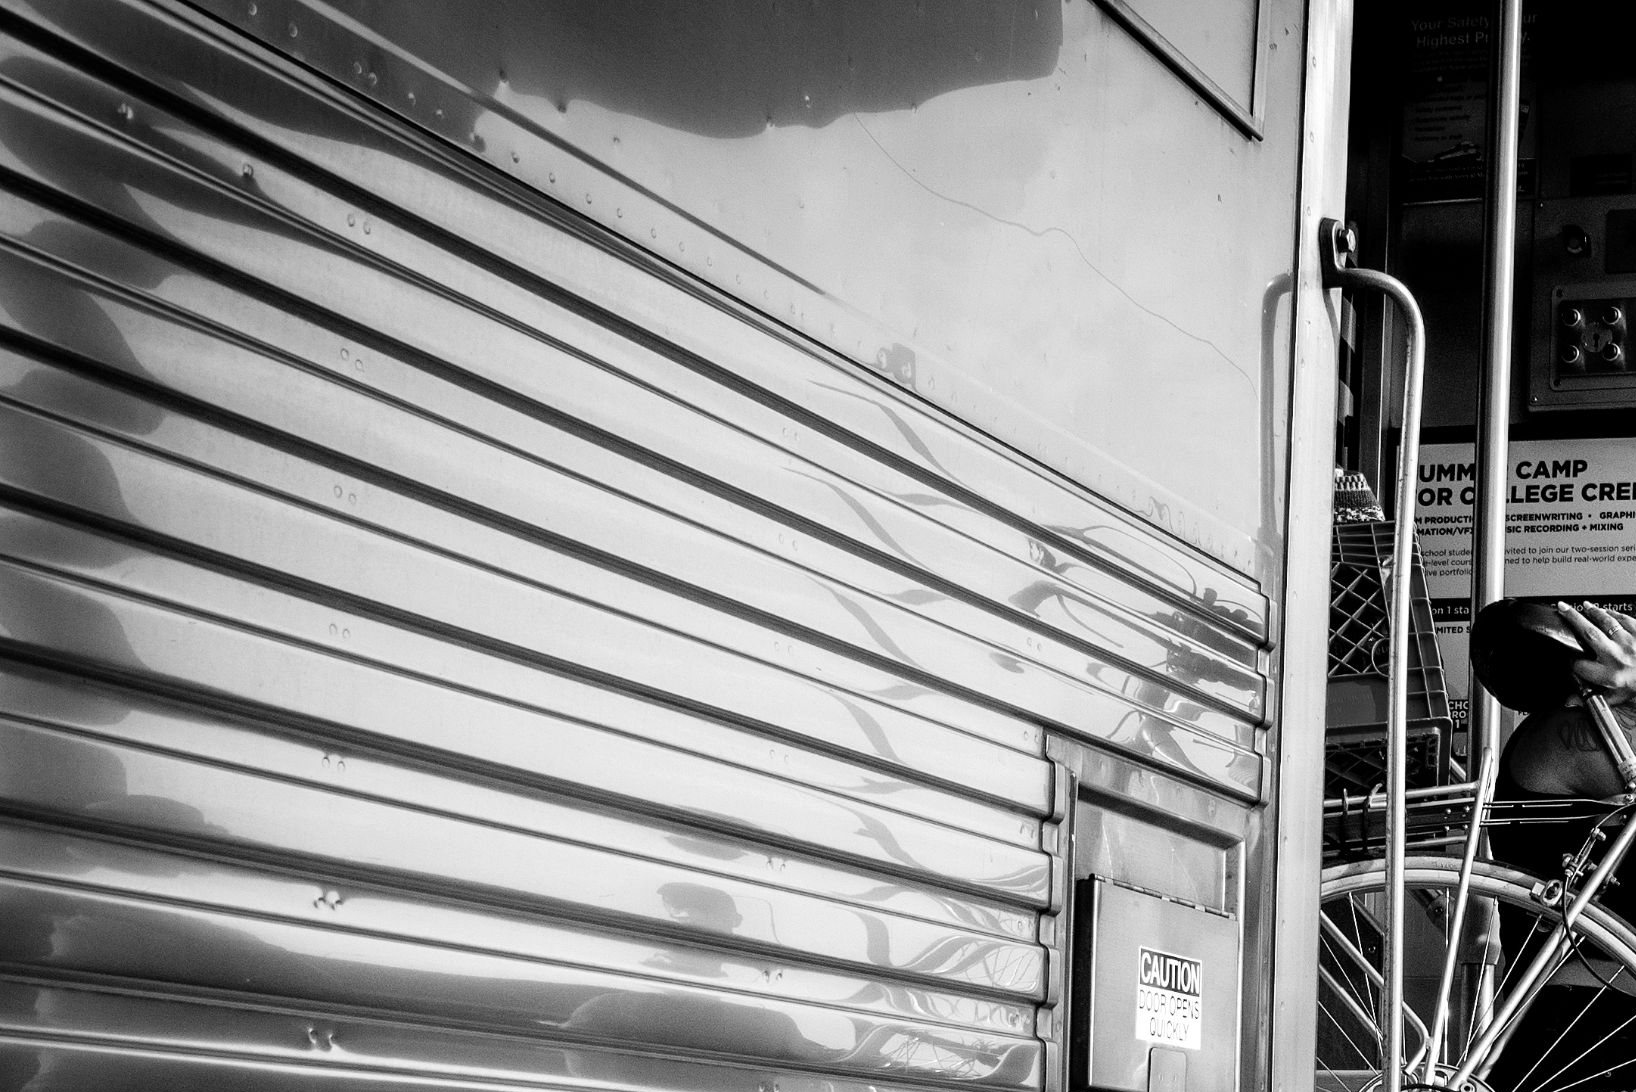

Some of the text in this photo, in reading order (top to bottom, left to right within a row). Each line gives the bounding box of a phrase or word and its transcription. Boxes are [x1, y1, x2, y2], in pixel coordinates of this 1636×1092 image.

[1411, 18, 1442, 31] Your
[1448, 15, 1489, 29] Safety
[1416, 31, 1469, 49] Highest
[1516, 460, 1588, 479] CAMP
[1417, 487, 1452, 506] OR
[1460, 484, 1574, 505] CLEGE
[1425, 515, 1473, 524] PRODUCTI
[1524, 524, 1579, 533] RECORDING
[1589, 523, 1624, 532] MIXING
[1448, 548, 1471, 556] stude
[1538, 546, 1554, 555] join
[1571, 545, 1618, 553] two-session
[1533, 556, 1550, 564] help
[1552, 555, 1572, 563] build
[1574, 554, 1615, 562] real-world
[1436, 626, 1463, 634] MITED
[1140, 951, 1201, 995] CAUTION
[1138, 988, 1200, 1020] DOOR OPENS
[1149, 1016, 1190, 1042] QUICKLY
